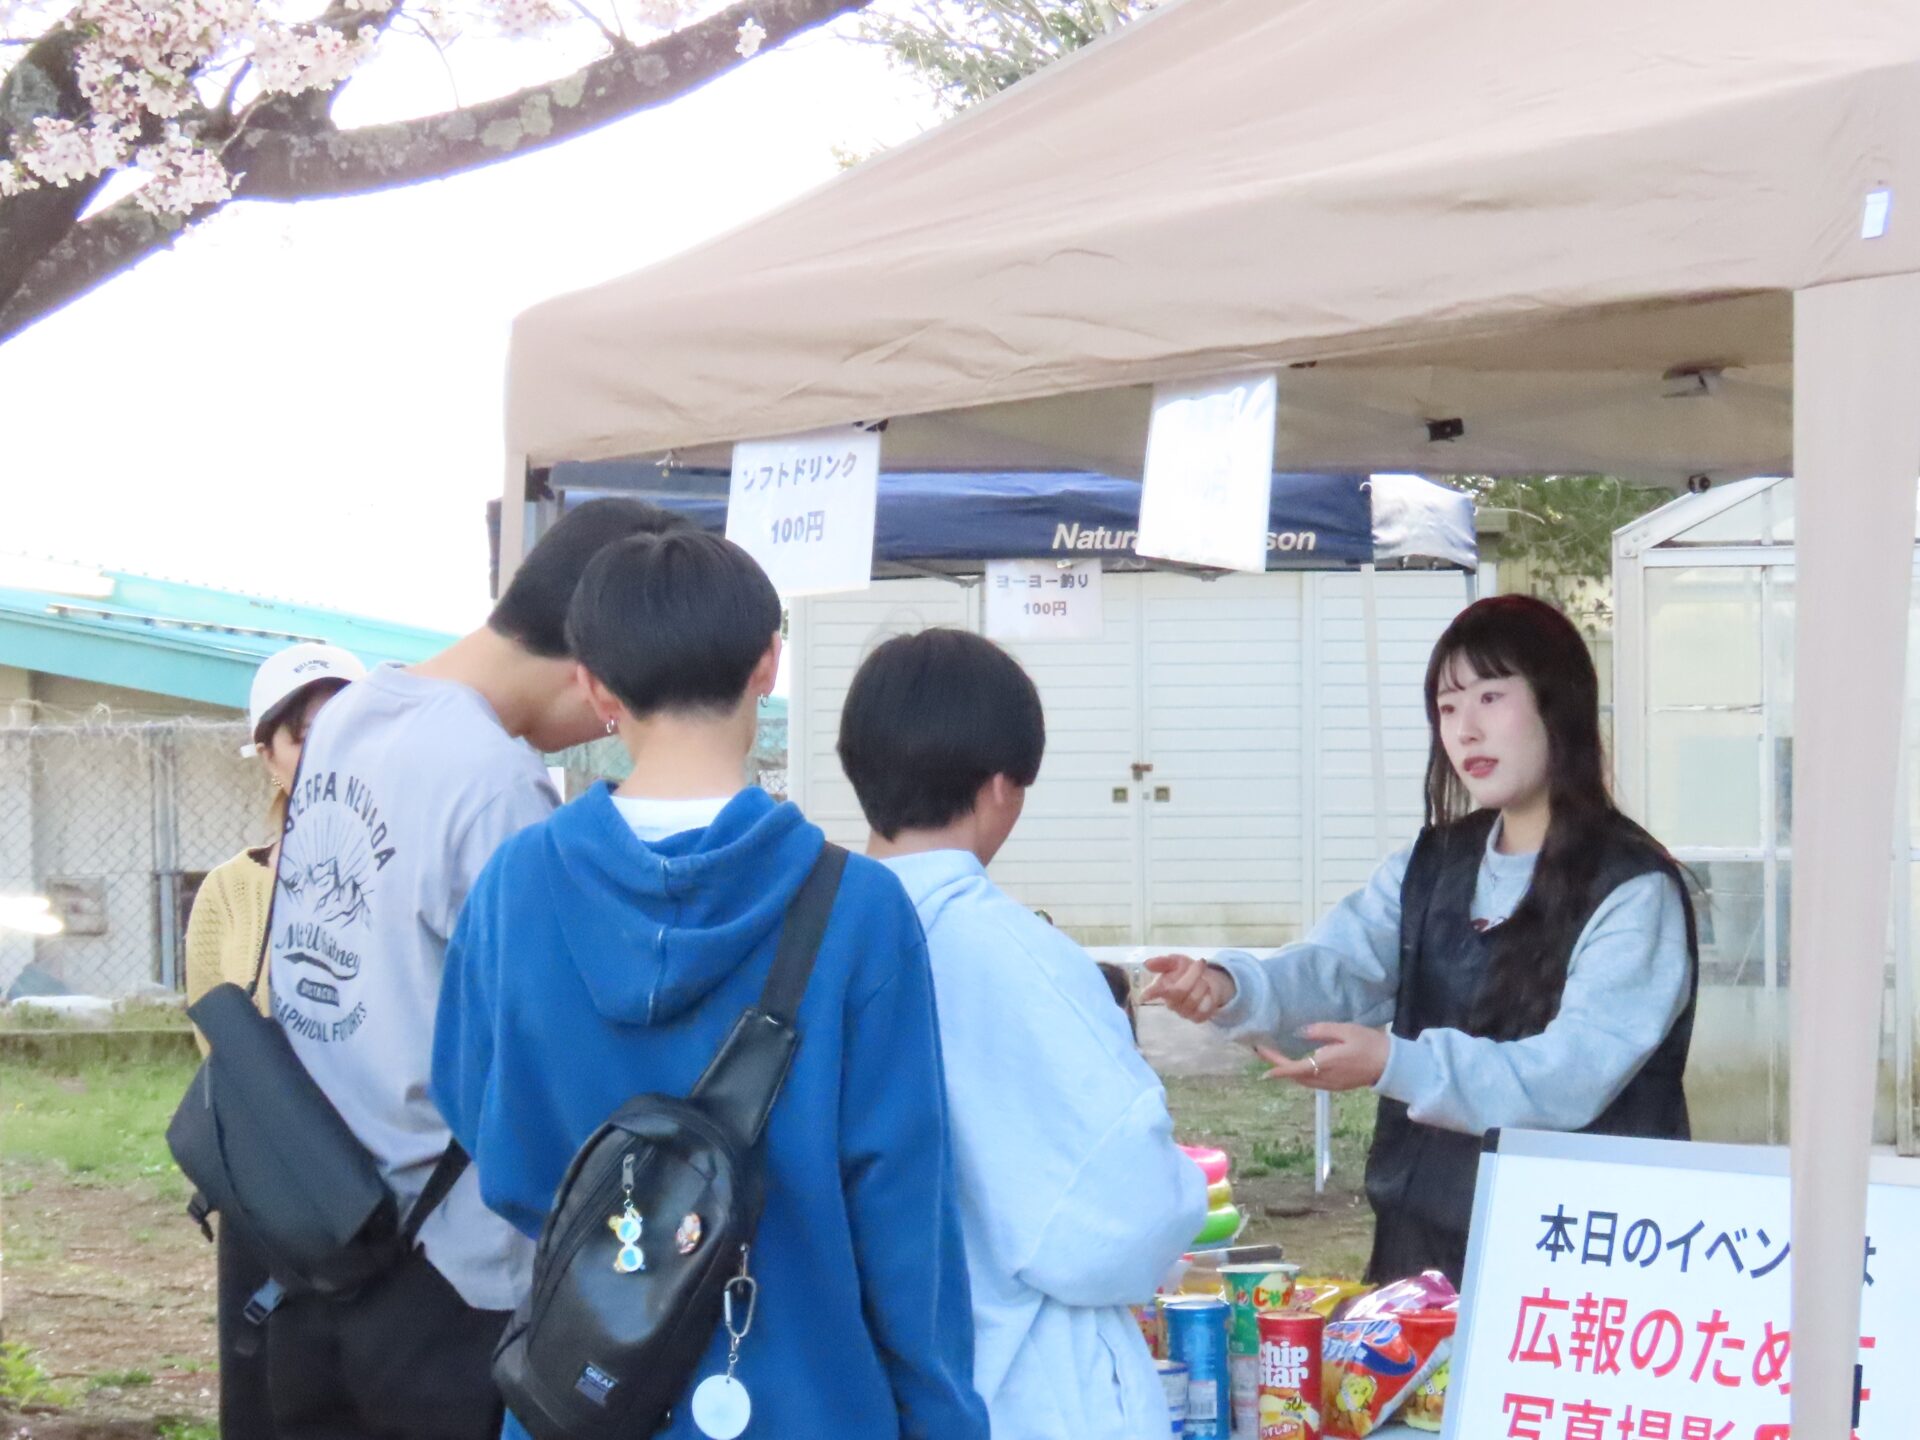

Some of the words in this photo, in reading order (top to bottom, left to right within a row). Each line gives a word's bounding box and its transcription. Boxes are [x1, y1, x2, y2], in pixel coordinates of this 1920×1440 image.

[771, 510, 825, 544] 100円
[996, 573, 1088, 589] ヨーヨー釣り
[1023, 601, 1067, 616] 100円
[344, 775, 396, 872] NEVADA
[1536, 1204, 1876, 1287] 本日のイベン
[1508, 1287, 1876, 1401] 広報のため
